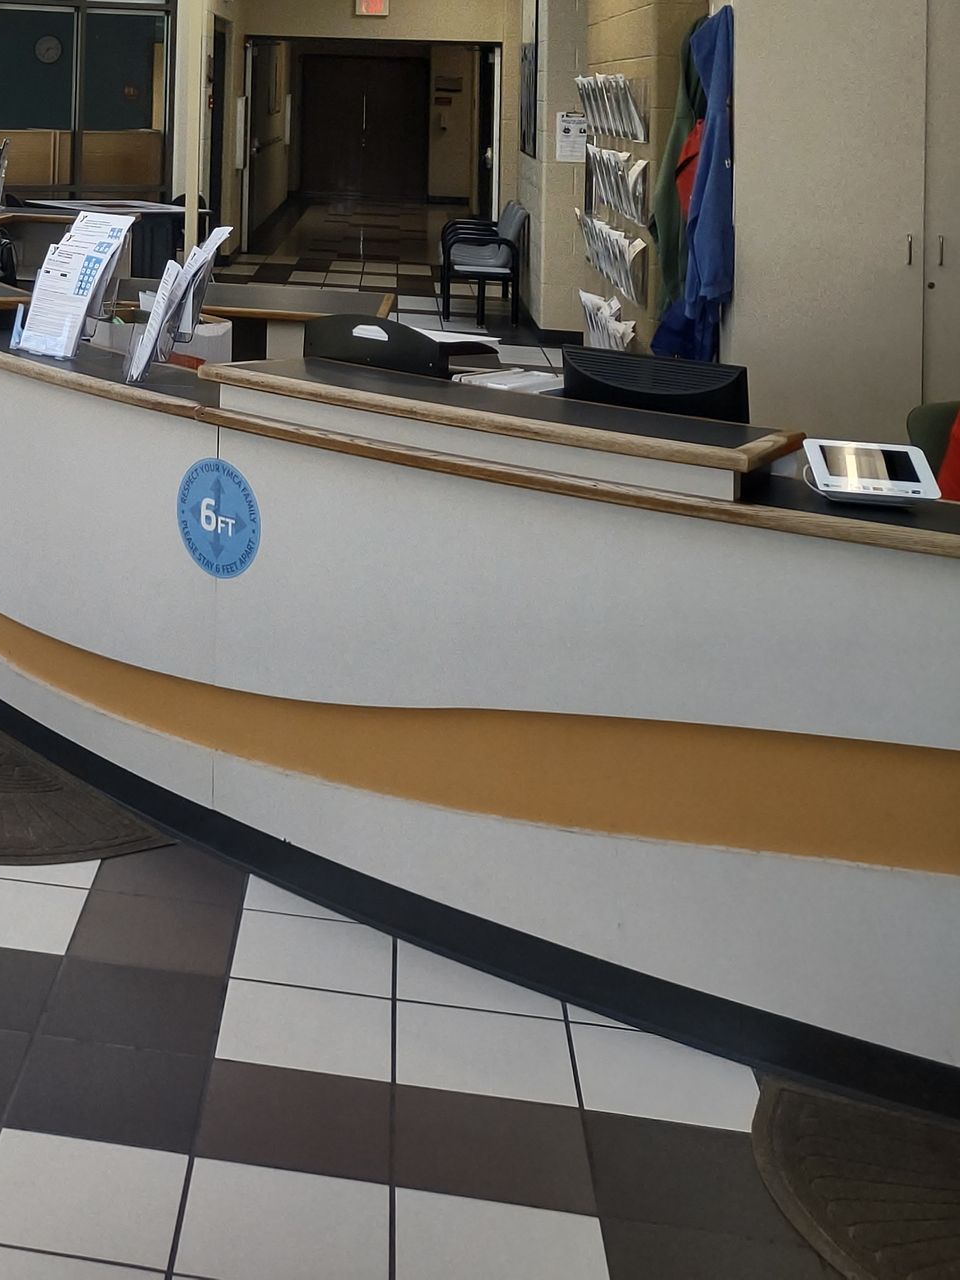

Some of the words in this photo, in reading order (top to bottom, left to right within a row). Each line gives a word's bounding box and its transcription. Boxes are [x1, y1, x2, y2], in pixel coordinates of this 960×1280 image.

[181, 469, 199, 504] RESPECT
[200, 463, 220, 474] YOUR
[222, 465, 242, 489] YMCA
[241, 487, 257, 524] FAMILY
[182, 520, 198, 556] PLEASE
[198, 553, 215, 571] STAY
[215, 564, 221, 574] 6
[221, 562, 239, 575] FEET
[239, 538, 256, 566] APART
